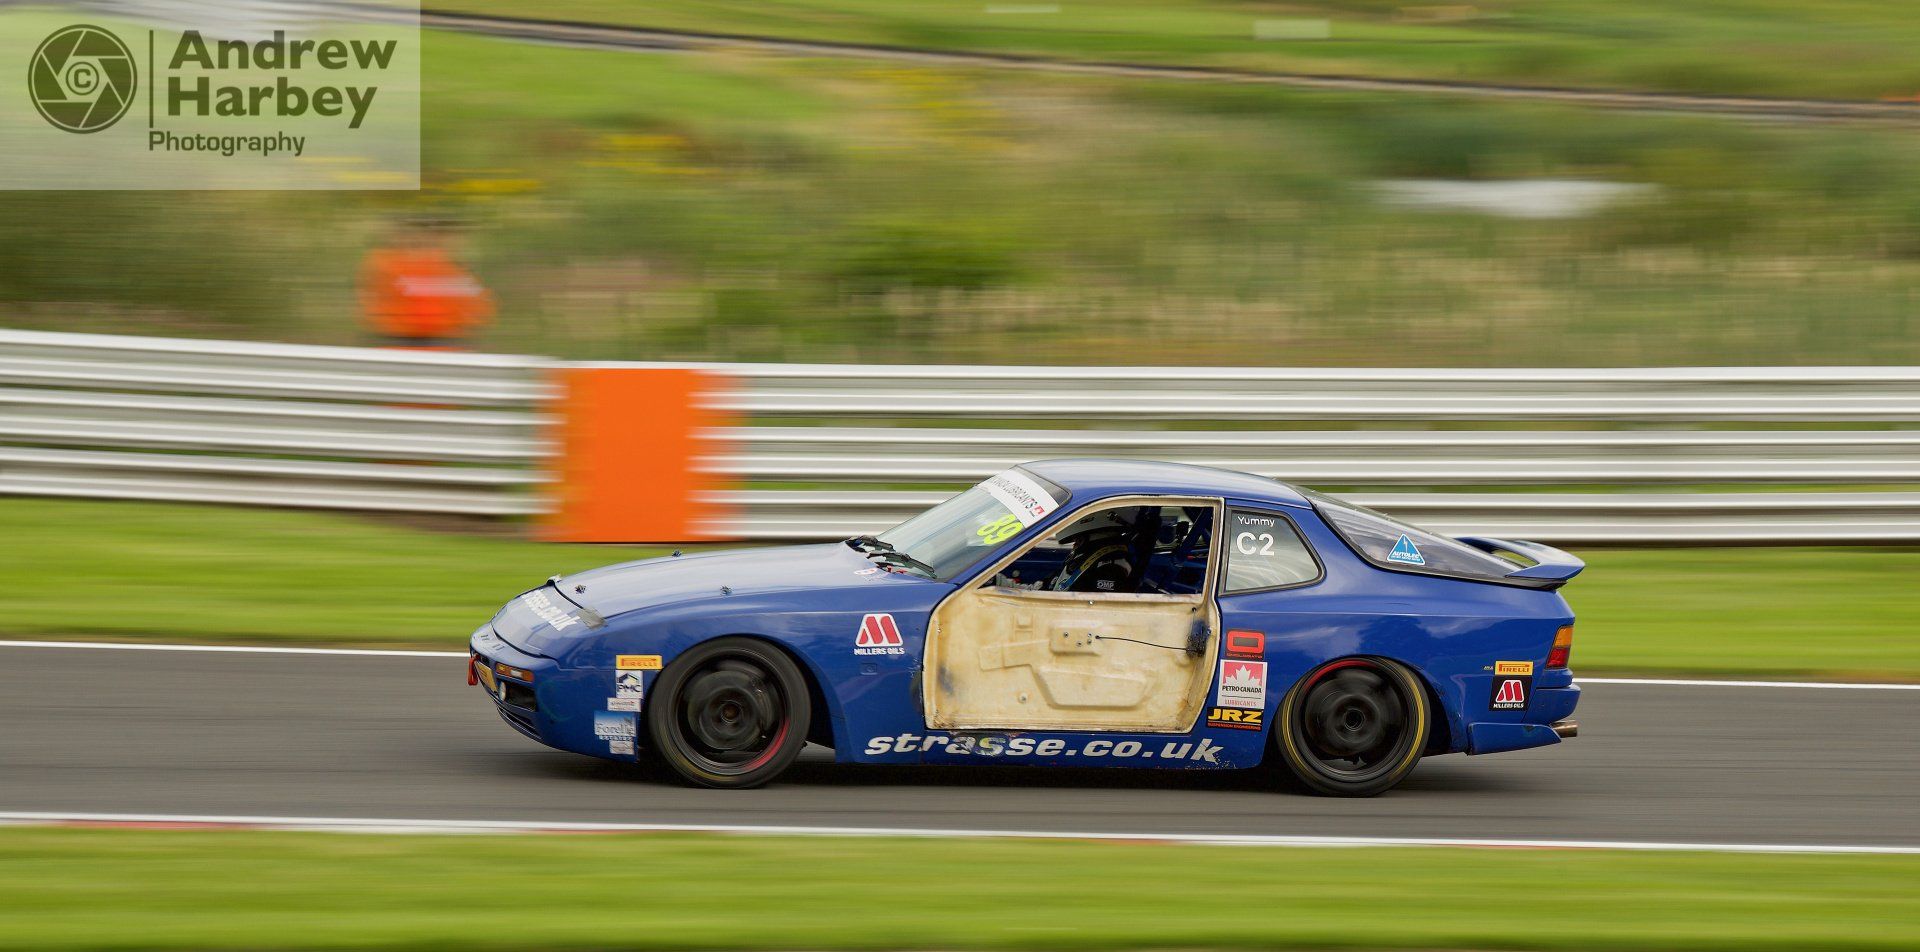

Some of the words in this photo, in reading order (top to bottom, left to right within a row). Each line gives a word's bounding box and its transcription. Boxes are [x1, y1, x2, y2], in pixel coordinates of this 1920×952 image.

[1238, 516, 1275, 527] Yummy
[977, 514, 1023, 544] 89
[1237, 532, 1274, 556] C2
[1097, 581, 1115, 589] OMP
[887, 647, 905, 655] OILS
[1498, 663, 1530, 672] PIRELLI
[1208, 708, 1263, 723] JRZ
[864, 733, 1224, 763] strasse.co.uk
